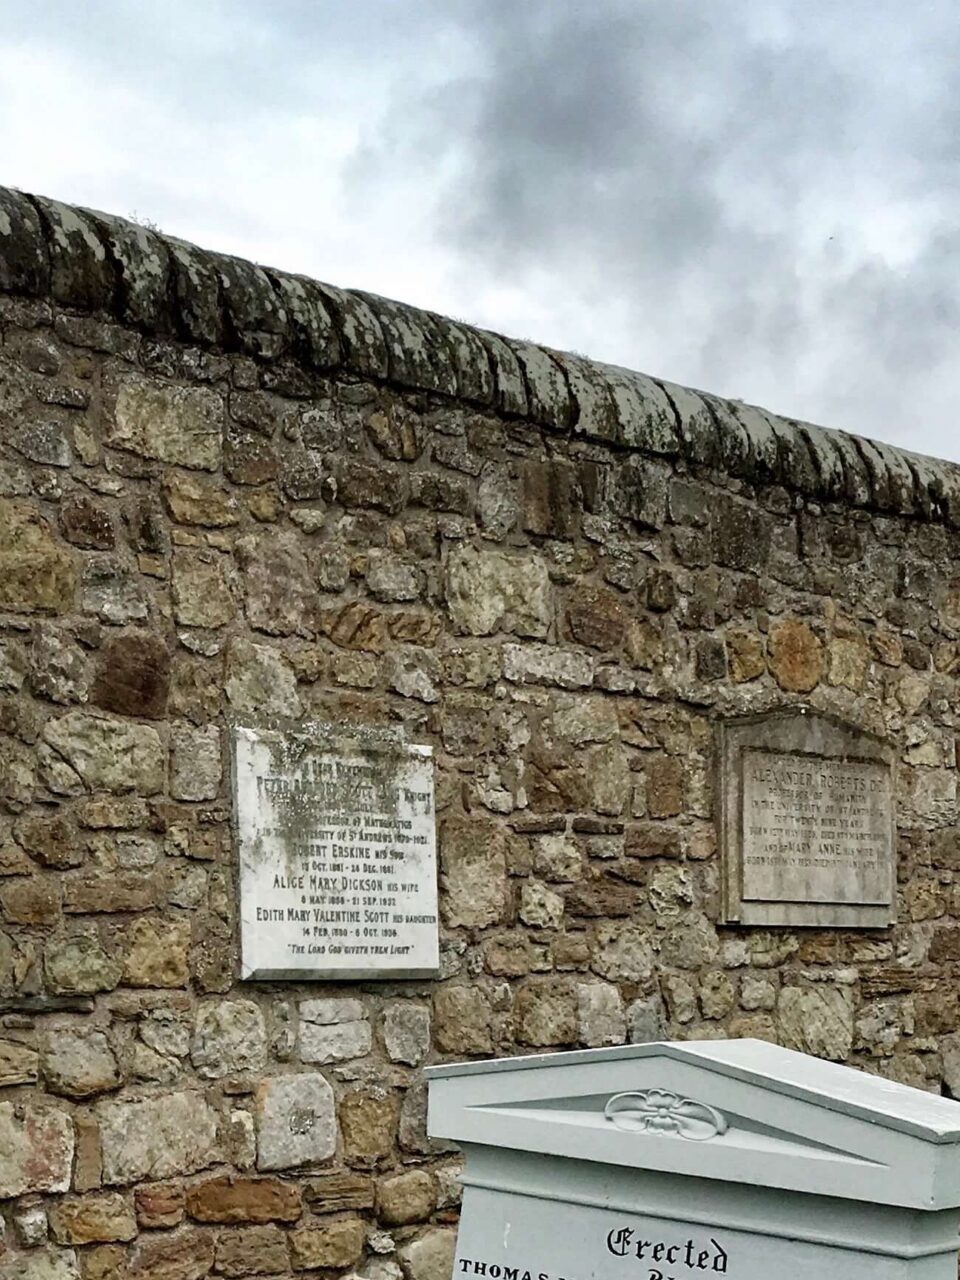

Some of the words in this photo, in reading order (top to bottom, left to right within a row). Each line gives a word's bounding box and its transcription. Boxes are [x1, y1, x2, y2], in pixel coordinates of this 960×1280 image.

[332, 844, 370, 859] ERSKINE
[273, 874, 304, 889] ALICE
[309, 875, 337, 891] MARY
[342, 877, 383, 892] DICKSON
[256, 907, 284, 922] EDITH
[287, 908, 310, 922] MARY
[313, 908, 360, 923] VALENTINE
[364, 910, 389, 924] SCOTT
[607, 1226, 728, 1273] Erected
